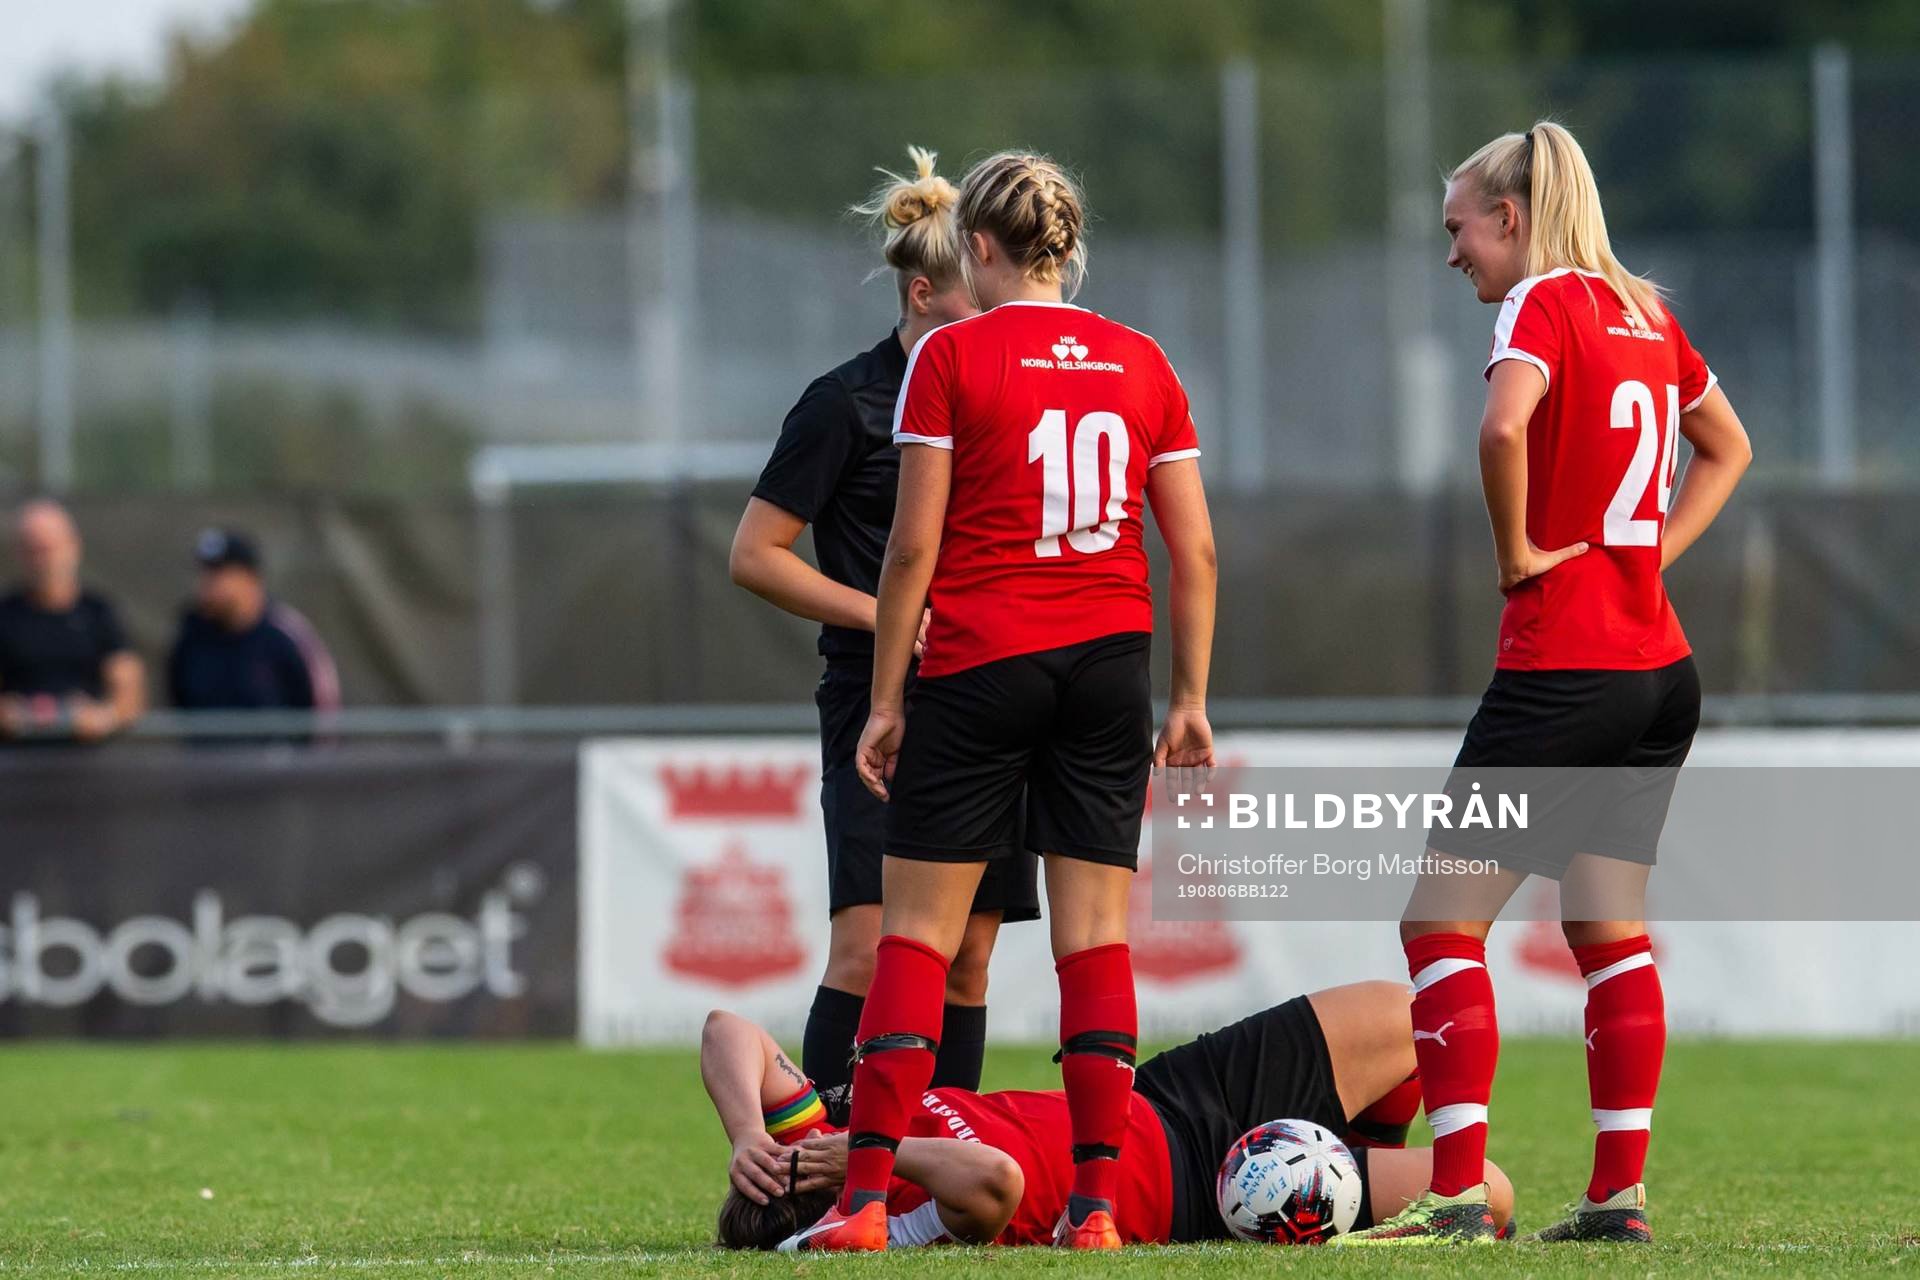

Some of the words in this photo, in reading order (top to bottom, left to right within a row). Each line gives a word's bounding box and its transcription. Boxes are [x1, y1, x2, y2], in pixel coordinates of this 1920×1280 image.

[1060, 336, 1077, 345] HIK
[1021, 358, 1054, 369] NORRA
[1057, 360, 1124, 373] HELSINGBORG
[1028, 409, 1130, 558] 10
[0, 888, 528, 1027] bolaget
[1240, 1162, 1260, 1191] DAM
